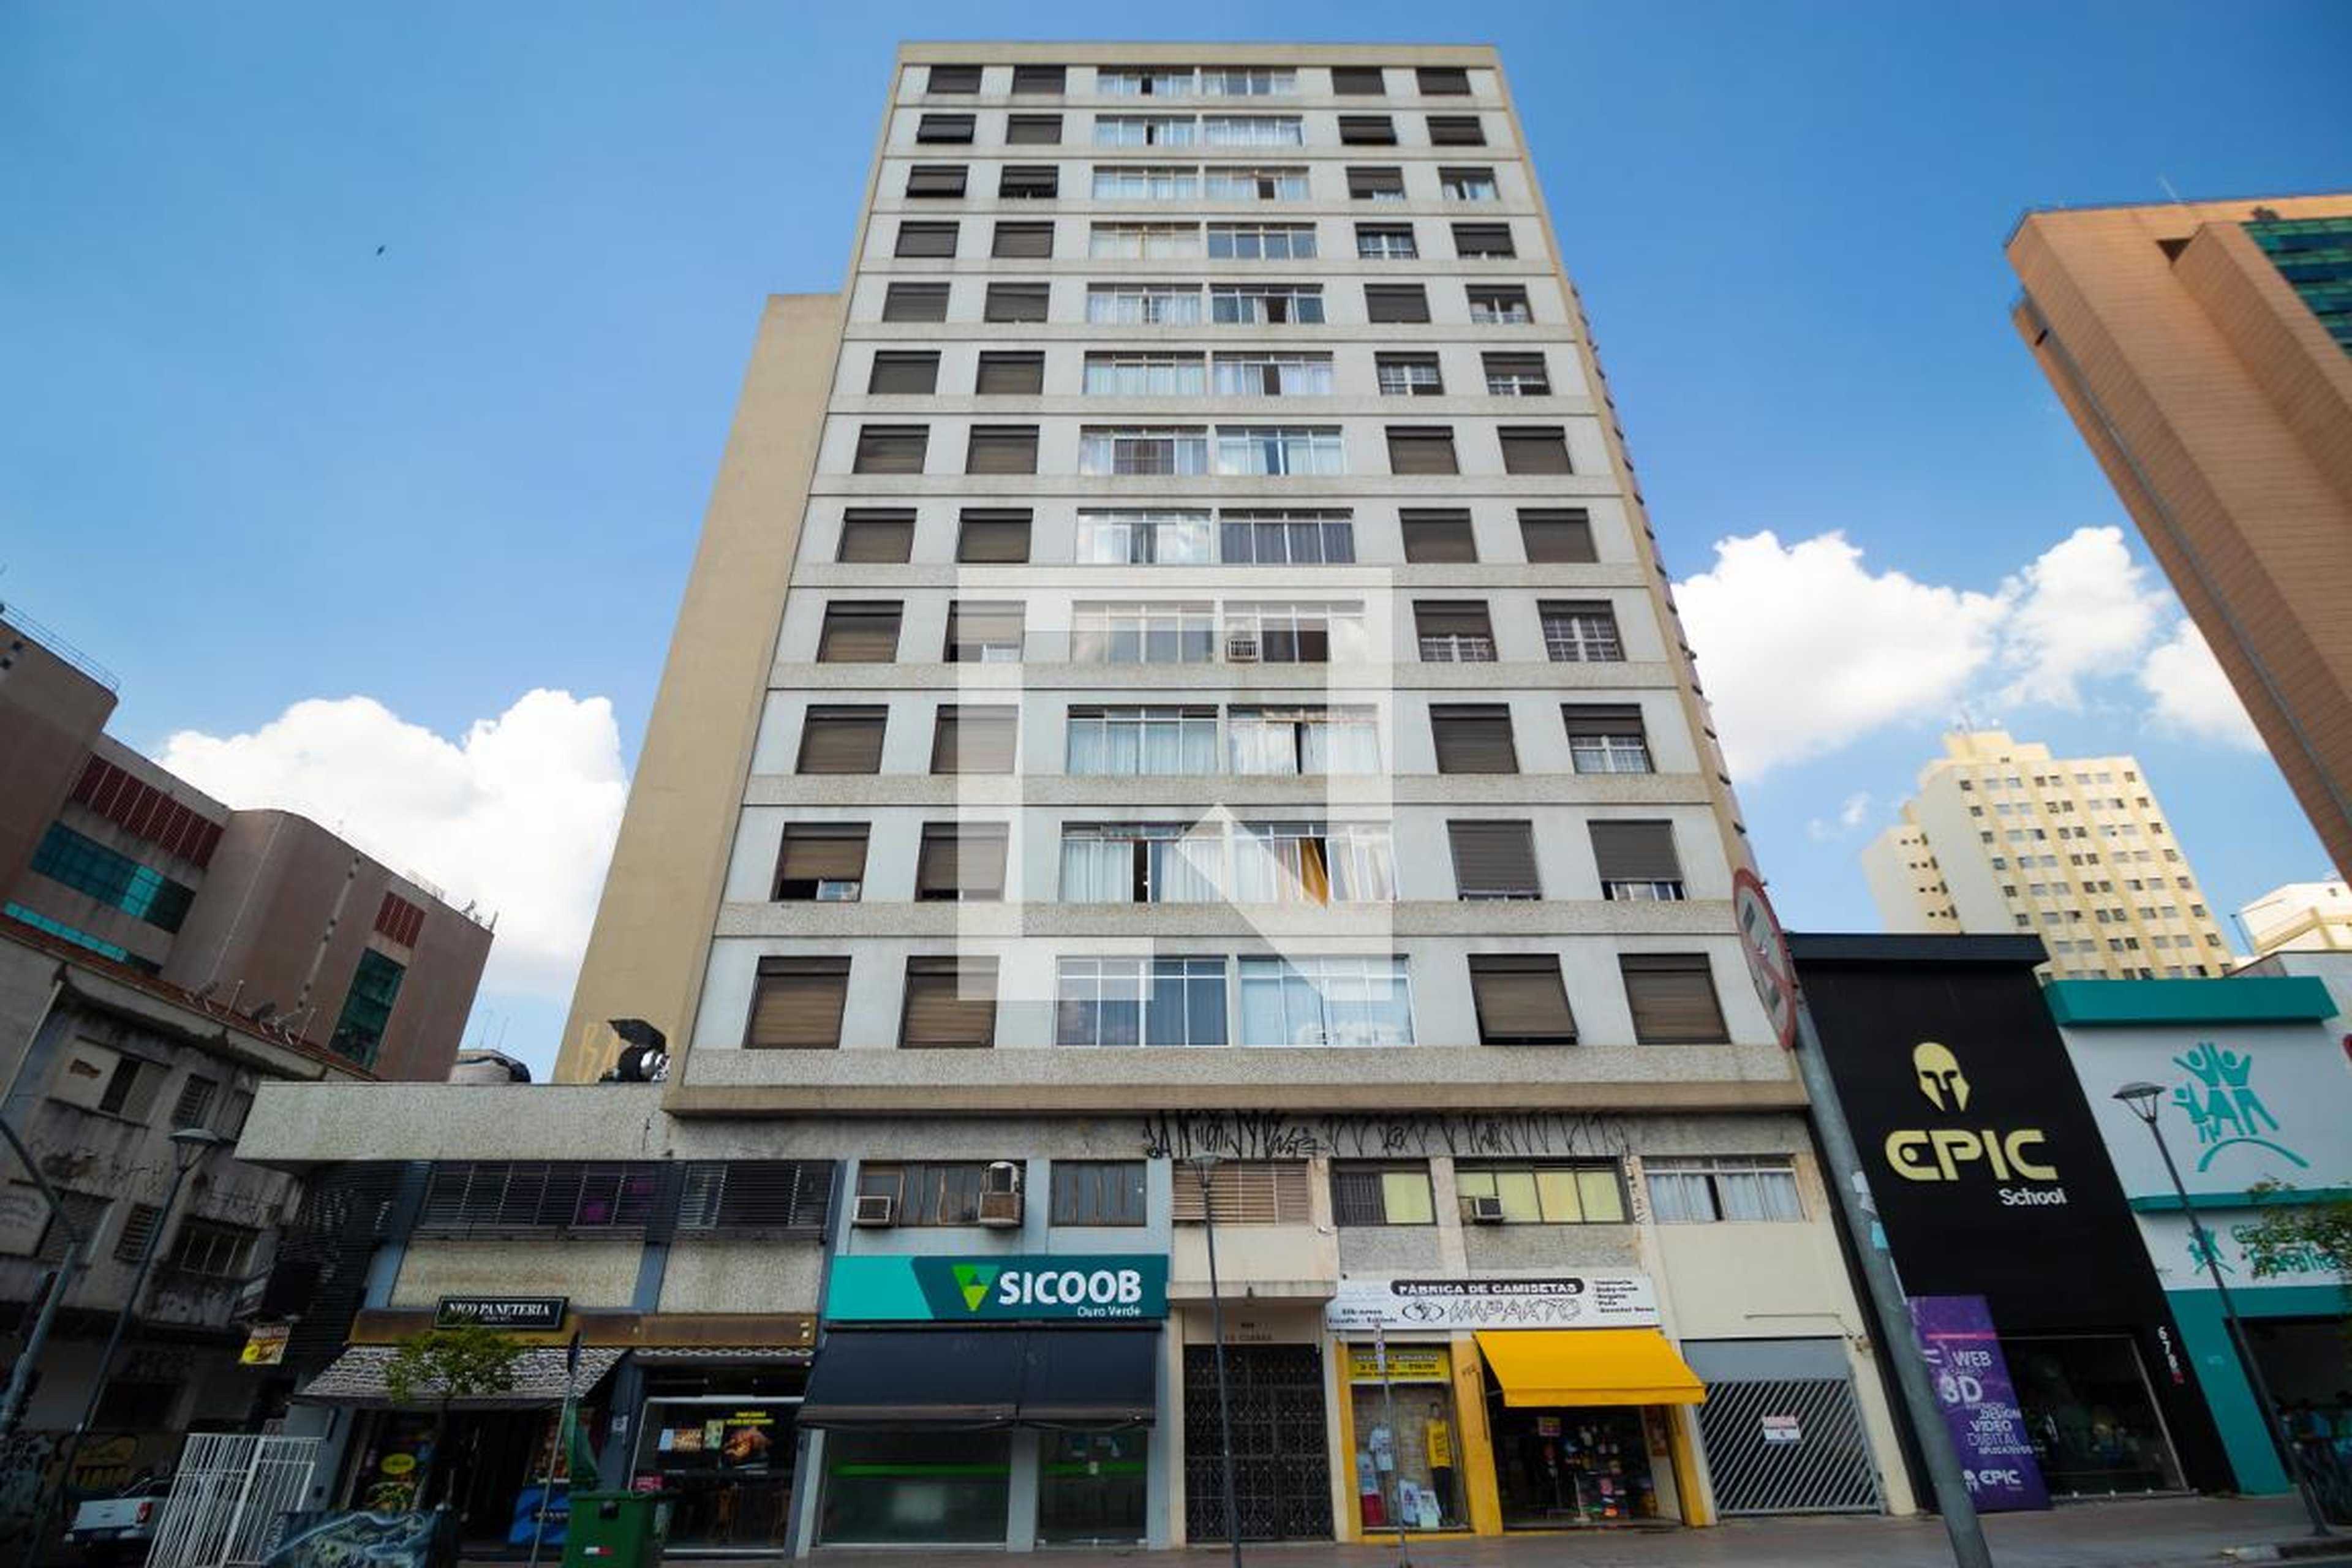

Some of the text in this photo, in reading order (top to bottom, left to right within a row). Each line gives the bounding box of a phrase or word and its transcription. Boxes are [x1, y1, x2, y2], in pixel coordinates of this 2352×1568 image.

[1885, 1129, 2059, 1180] EPIC
[1999, 1187, 2068, 1205] School
[998, 1270, 1142, 1305] SICOOB
[1469, 1283, 1489, 1294] DE
[1491, 1282, 1577, 1294] CAMISETAS
[1077, 1305, 1142, 1317] Ouro Verde
[1951, 1351, 1992, 1366] WEB
[1939, 1375, 1983, 1404] 3D
[1978, 1470, 2022, 1485] EPIC
